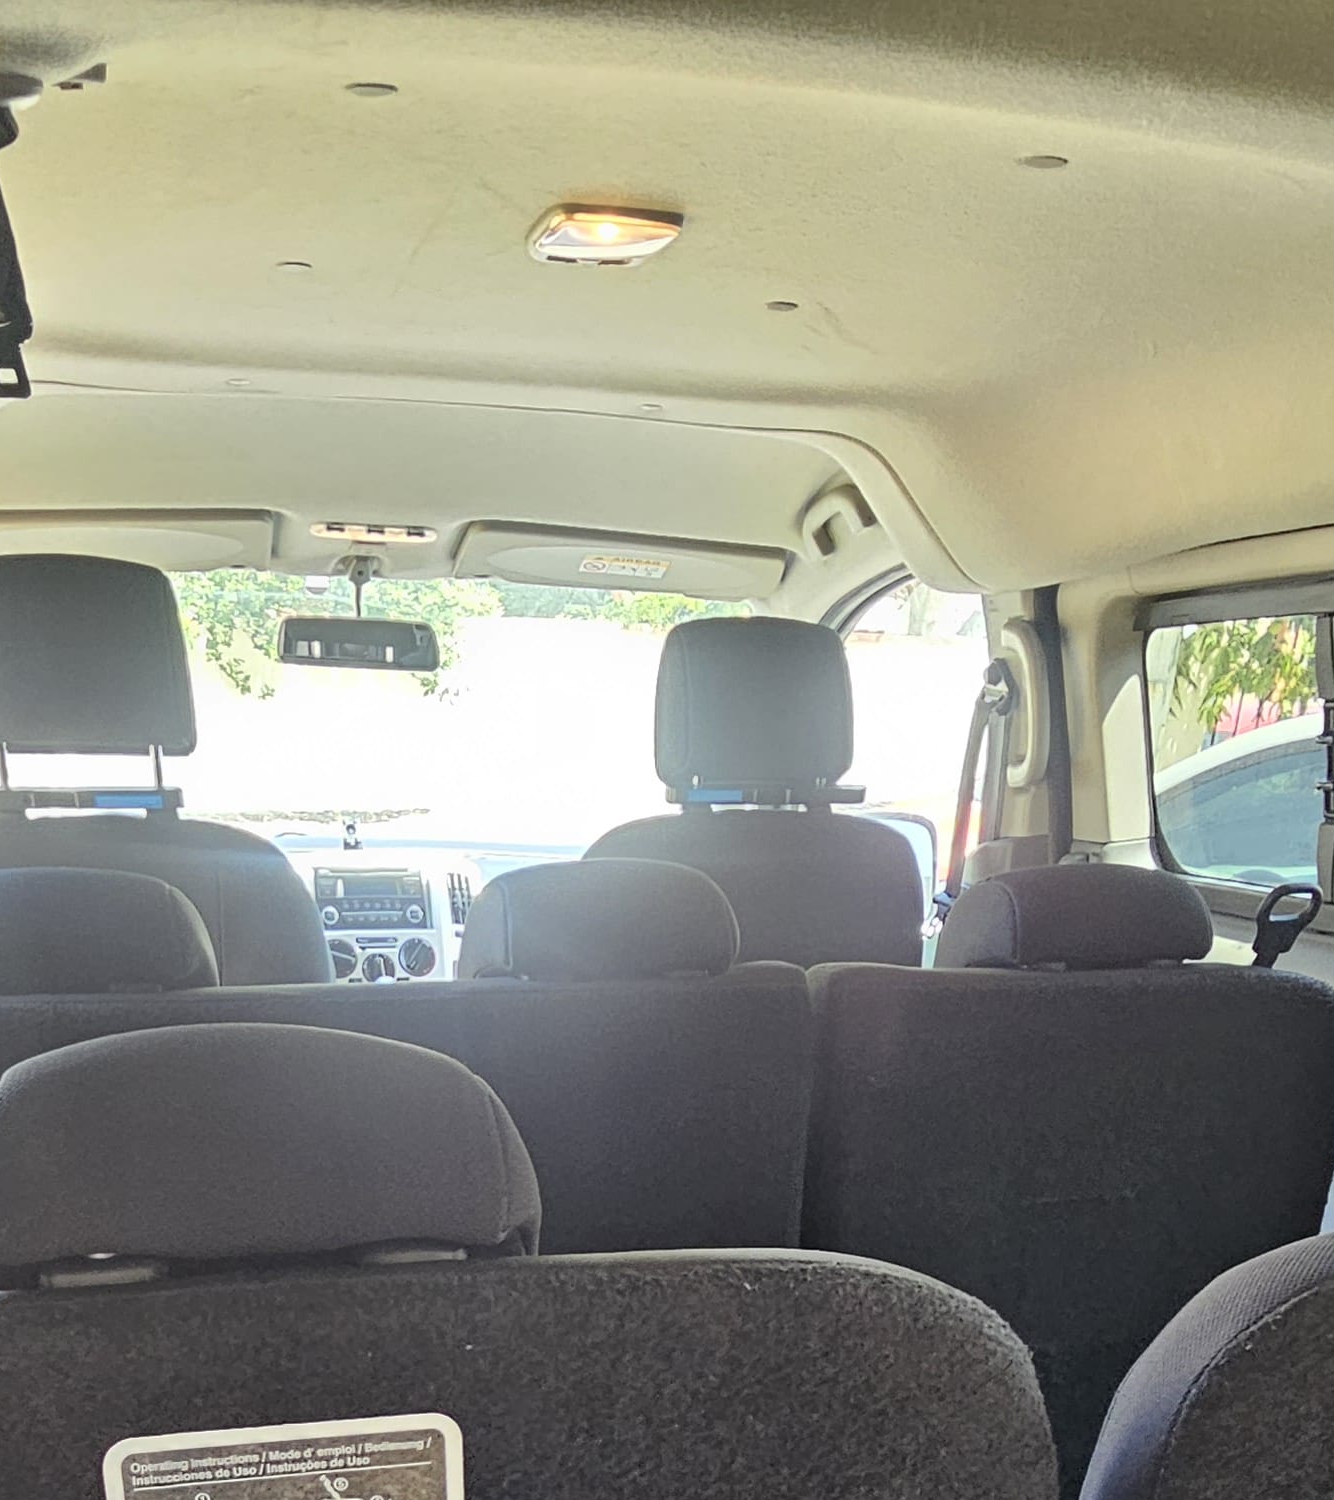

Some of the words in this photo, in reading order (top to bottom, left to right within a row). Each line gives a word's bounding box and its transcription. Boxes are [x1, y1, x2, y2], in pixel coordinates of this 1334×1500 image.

[269, 1449, 301, 1461] Mode
[318, 1444, 356, 1458] emploi
[364, 1440, 424, 1453] Bedig
[131, 1470, 213, 1486] Instrucciones
[215, 1468, 230, 1478] de
[233, 1465, 257, 1477] Uso
[329, 1458, 345, 1469] de
[346, 1455, 370, 1467] Uso
